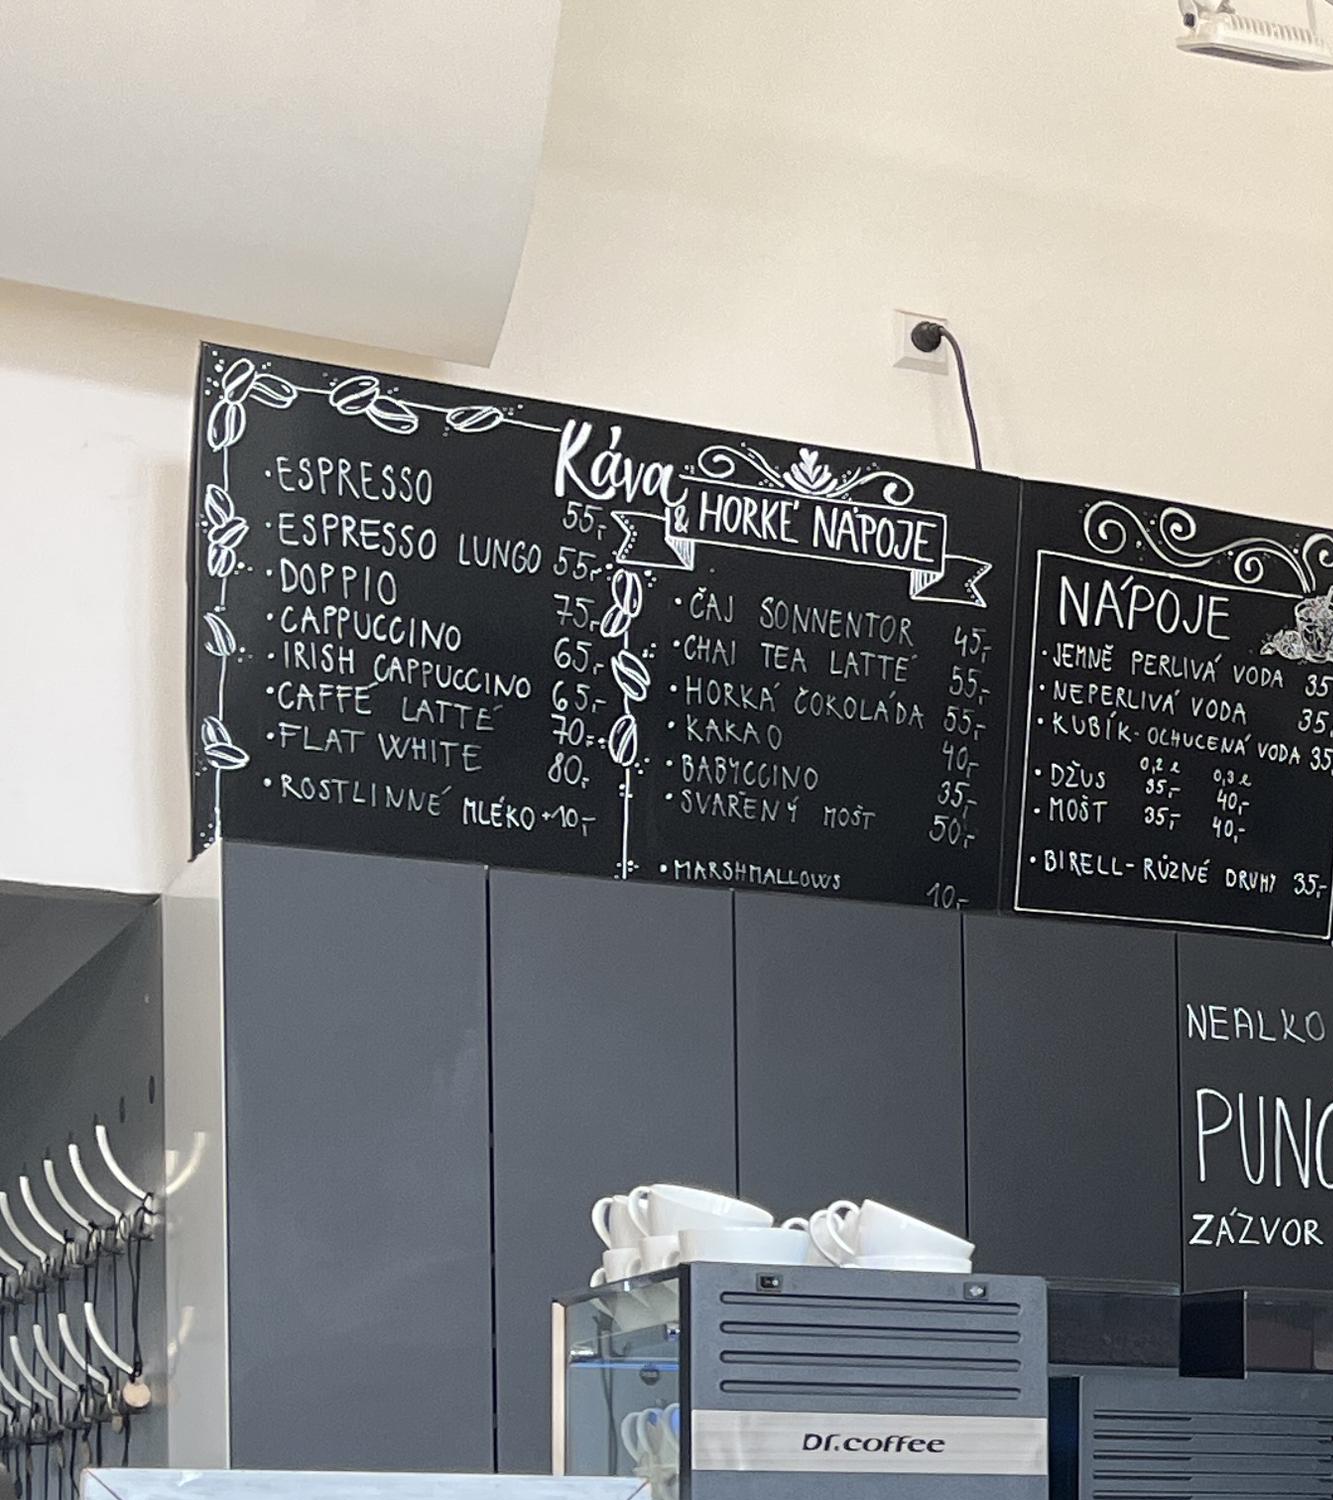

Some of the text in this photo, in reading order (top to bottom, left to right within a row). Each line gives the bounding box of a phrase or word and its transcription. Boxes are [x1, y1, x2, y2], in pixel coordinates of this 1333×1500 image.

[276, 456, 432, 505] ESPRESSO
[554, 420, 689, 507] Káva
[278, 512, 437, 560] ESPRESSO
[458, 533, 542, 574] LUNGO
[674, 490, 937, 563] & HORKÉ NÁPOJE
[279, 557, 397, 606] DOPPIO
[1059, 574, 1230, 640] NÁPOJE
[280, 605, 461, 652] CAPPUCCINO
[689, 586, 992, 664] ČAJ SONNENTOR 45,-
[284, 641, 355, 675] IRISH
[373, 653, 531, 699] CAPPUCCINO
[683, 634, 736, 667] CHAI
[760, 642, 807, 673] TEA
[949, 665, 991, 705] 55,-
[1052, 642, 1114, 672] JEMNĚ
[1131, 650, 1222, 683] PERLIVÁ
[1233, 664, 1284, 688] VODA
[685, 675, 986, 741] HORKÁ ČOKOLÁDA 55,-
[1053, 679, 1180, 718] NEPERLIVÁ
[1191, 697, 1247, 725] VODA
[278, 721, 365, 753] FLAT
[377, 732, 482, 772] WHITE
[686, 713, 980, 779] KAKAO 40,-
[1147, 726, 1252, 756] OCHUCENÁ
[1257, 742, 1301, 765] VODA
[280, 773, 452, 816] ROSTLINNÉ
[463, 795, 535, 831] MLÉKO
[681, 753, 978, 819] BABYCCINO 35,-
[1051, 759, 1106, 790] DŽUS
[1216, 788, 1250, 816] 40,-
[680, 788, 976, 849] SVAŘENÝ MOŠT 50,-
[1049, 794, 1246, 844] MOŠT 35,- 40,-
[673, 859, 841, 892] MARSHMALLOWS
[1143, 854, 1211, 884] RŮZNÉ
[1225, 868, 1277, 893] DRUHY
[1293, 872, 1328, 899] 35,-
[1186, 1003, 1325, 1043] NEALKO
[1188, 1206, 1324, 1247] ZÁZVOR
[801, 1432, 946, 1454] Dr.coffee
